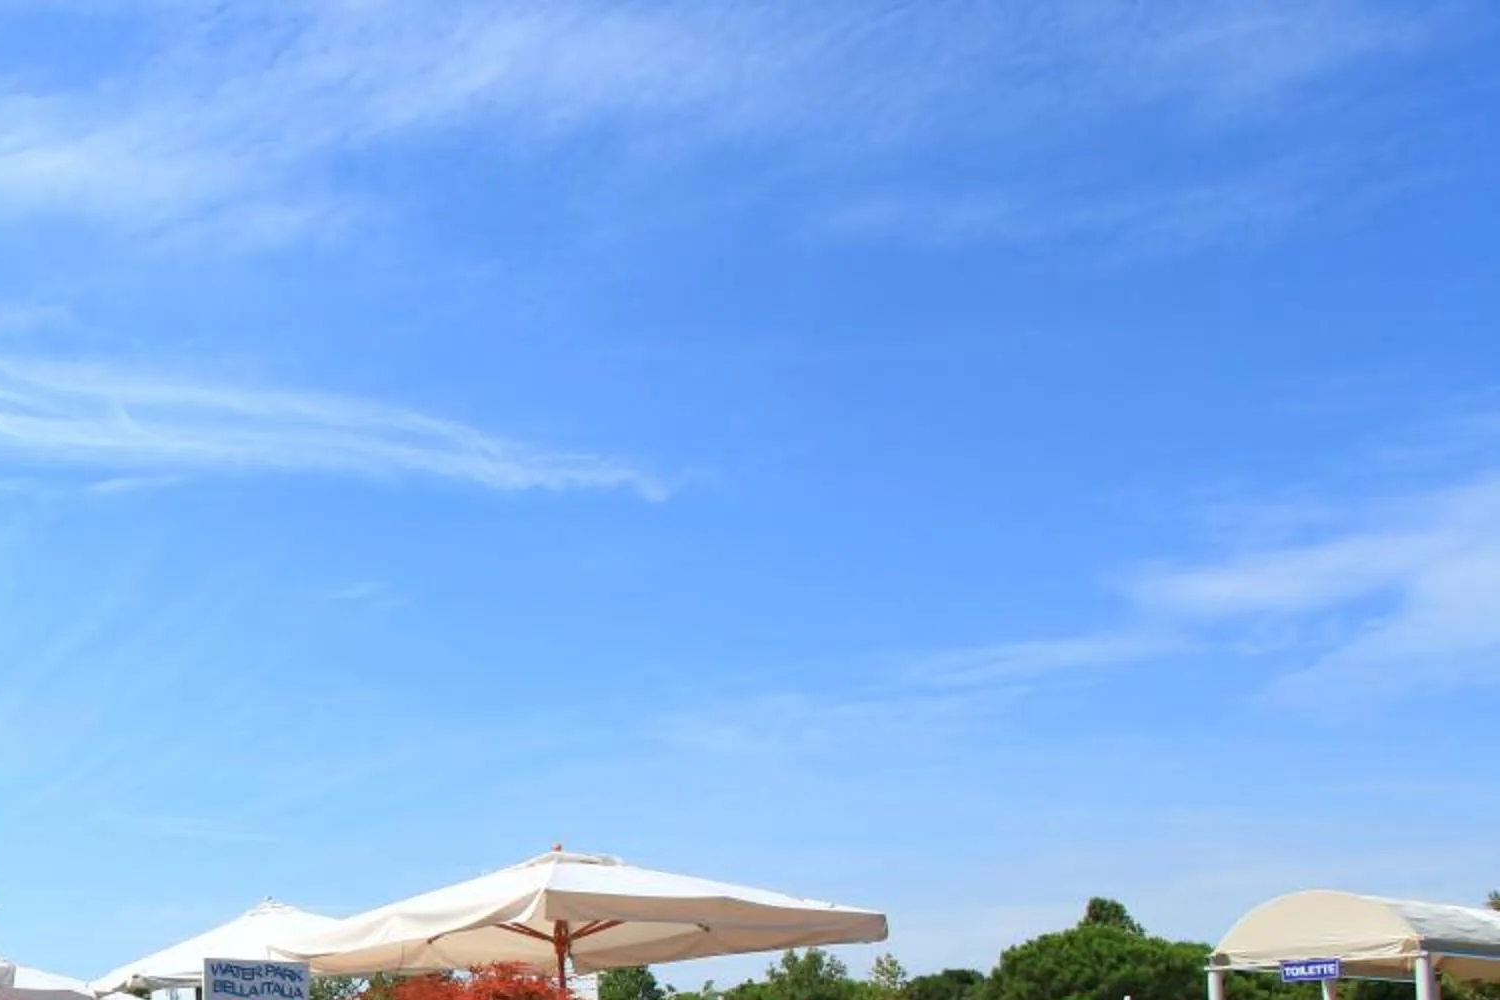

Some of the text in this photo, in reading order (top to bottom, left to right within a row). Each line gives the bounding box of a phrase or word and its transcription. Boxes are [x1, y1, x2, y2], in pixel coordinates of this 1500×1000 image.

[210, 963, 304, 983] WATER PARK
[1283, 963, 1336, 977] TOILETTE
[212, 979, 304, 1000] BELLA ITALIA
